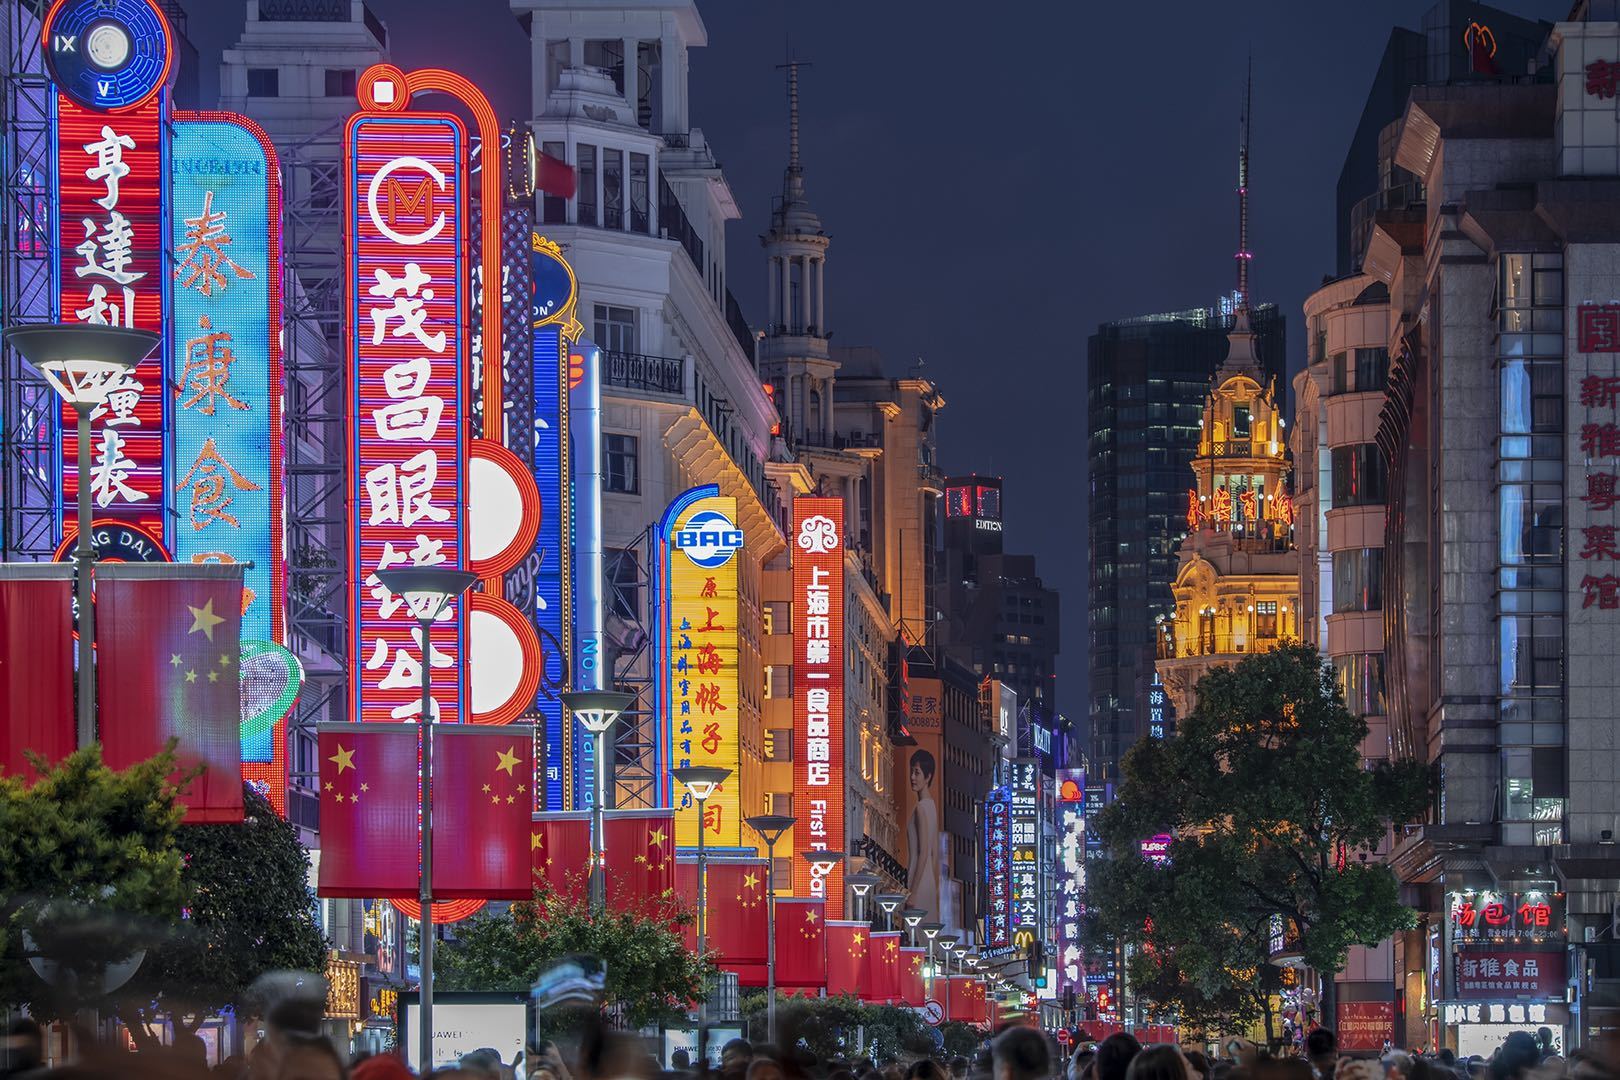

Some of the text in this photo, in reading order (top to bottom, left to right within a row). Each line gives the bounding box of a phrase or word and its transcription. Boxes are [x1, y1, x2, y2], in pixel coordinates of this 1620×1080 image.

[55, 36, 76, 52] IX
[174, 190, 264, 564] 泰康食
[677, 531, 742, 547] BAC
[975, 519, 1002, 532] EDITION
[806, 565, 830, 786] 上海市第一食品商店
[676, 616, 693, 808] 上海卧室用品有限司
[1150, 672, 1164, 738] 上海置地
[810, 800, 827, 837] First
[1020, 872, 1037, 926] 真丝大王
[1463, 958, 1539, 978] 新雅食品
